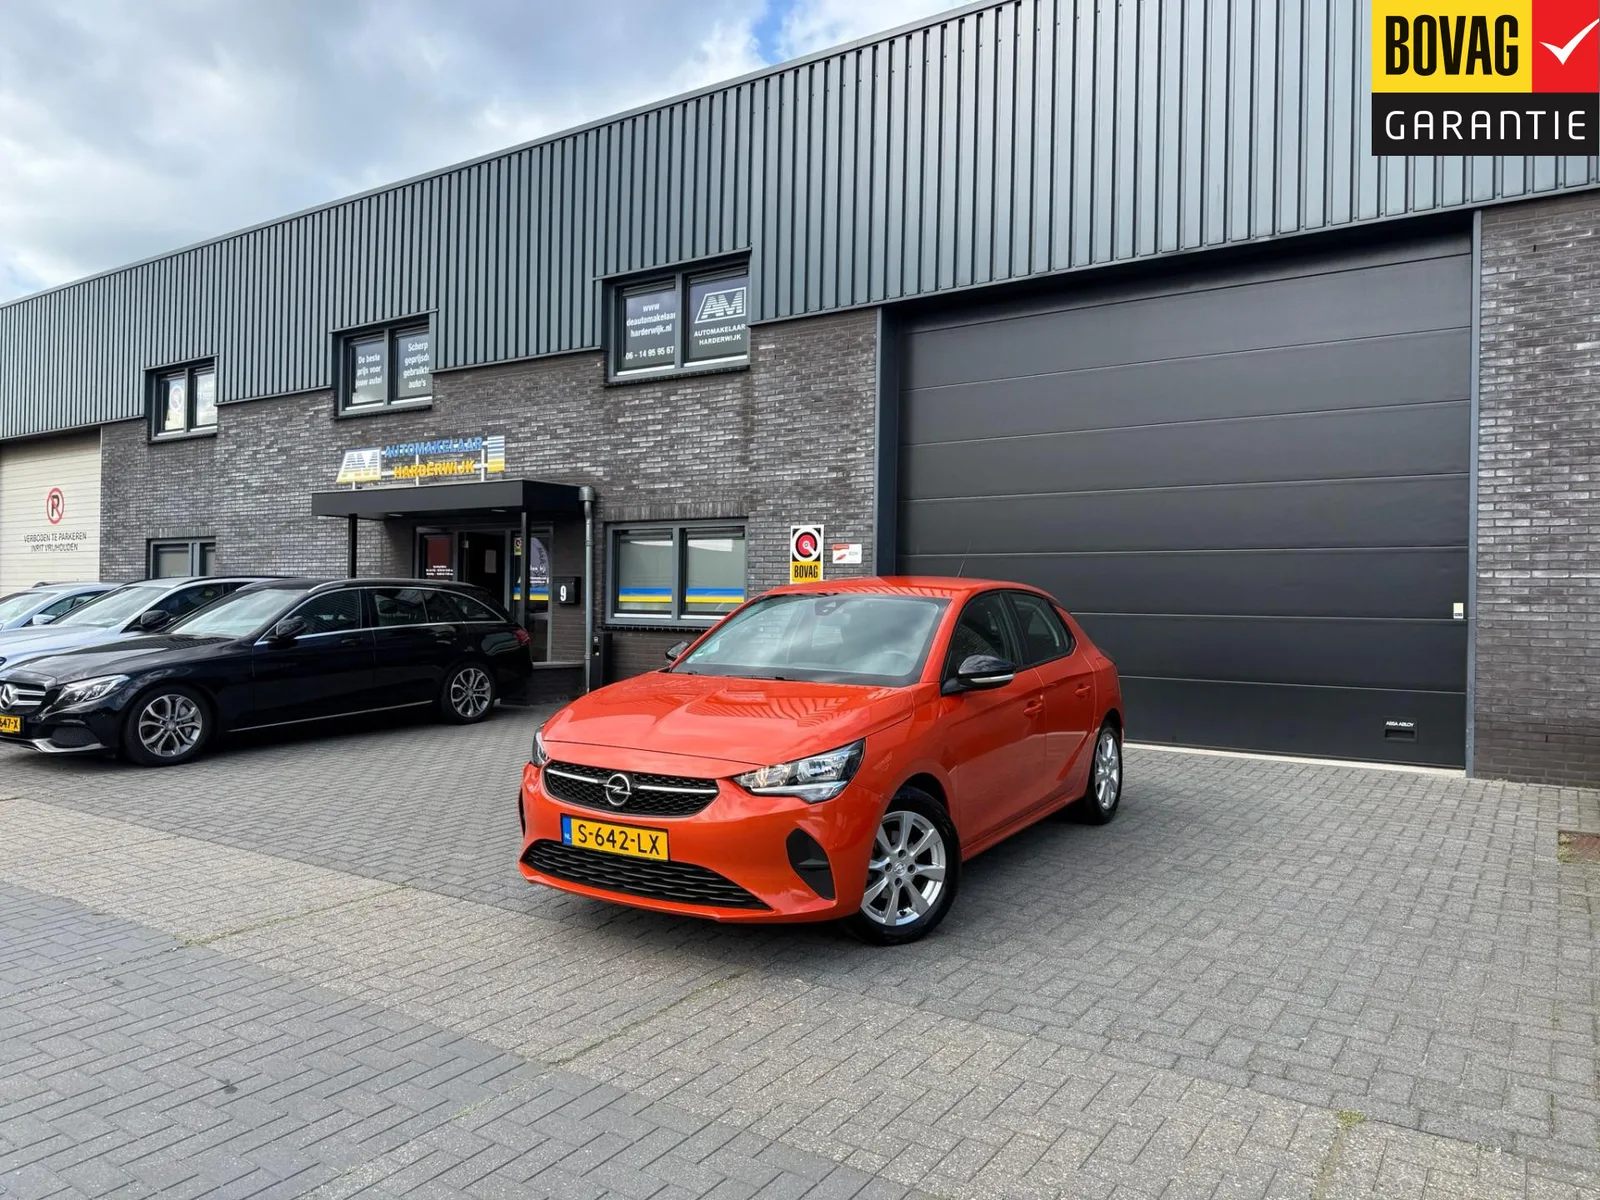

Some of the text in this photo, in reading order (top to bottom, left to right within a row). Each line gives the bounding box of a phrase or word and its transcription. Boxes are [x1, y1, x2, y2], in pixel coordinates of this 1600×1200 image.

[643, 303, 660, 312] www
[630, 324, 672, 337] harderwijk.nl
[694, 324, 746, 337] AUTOMAKELAAR
[699, 334, 741, 346] HARDERWIJK
[408, 342, 428, 352] Scherp
[639, 349, 646, 357] 14
[657, 346, 666, 355] 95
[358, 356, 365, 364] De
[408, 379, 427, 388] auto's
[384, 437, 483, 457] AUTOMAKELAAR
[393, 460, 475, 479] HARDERWIJK
[23, 532, 87, 543] VERBODEN TE PARKEREN
[794, 565, 818, 578] BOVAG
[559, 585, 567, 601] 9
[577, 824, 660, 855] S-642-LX
